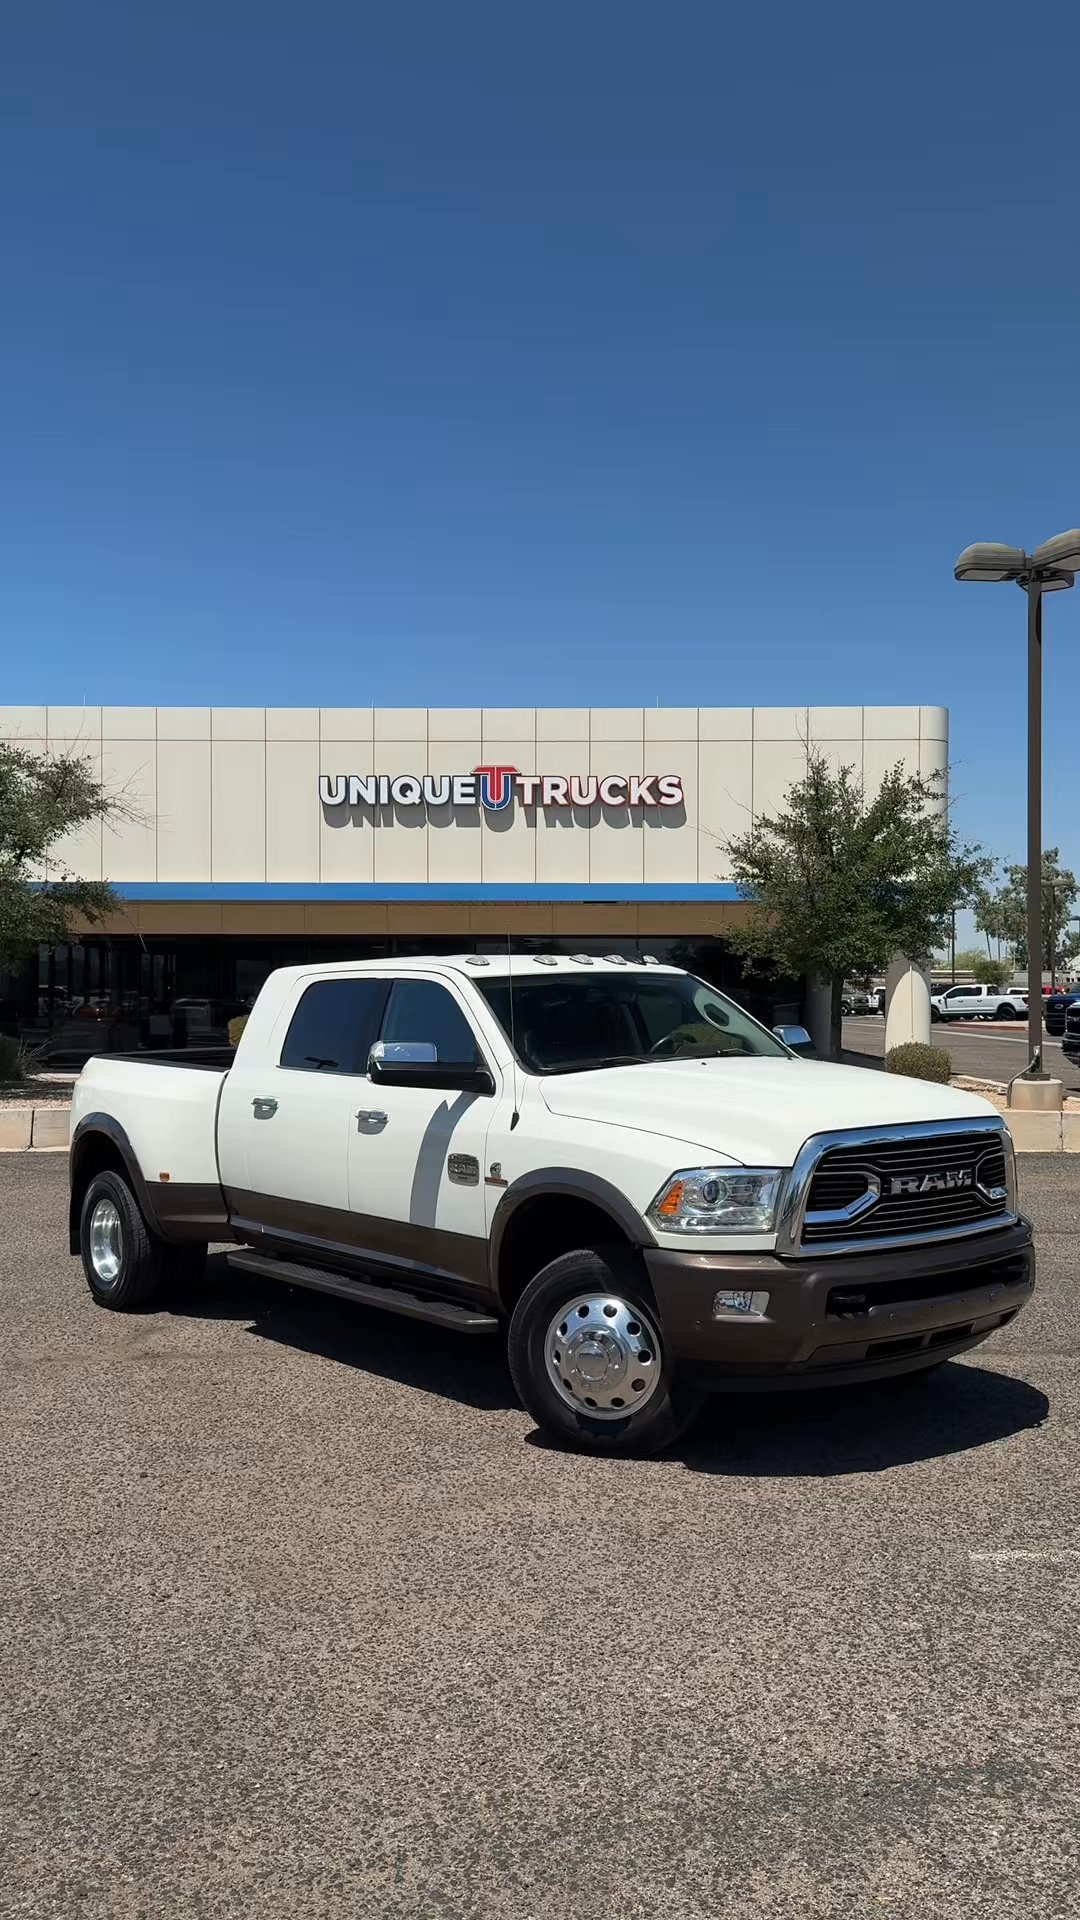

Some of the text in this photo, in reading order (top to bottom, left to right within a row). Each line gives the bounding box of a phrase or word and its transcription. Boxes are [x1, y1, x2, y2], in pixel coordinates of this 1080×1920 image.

[319, 775, 476, 806] UNIQUE
[515, 775, 684, 806] TRUCKS
[890, 1169, 972, 1195] RAM
